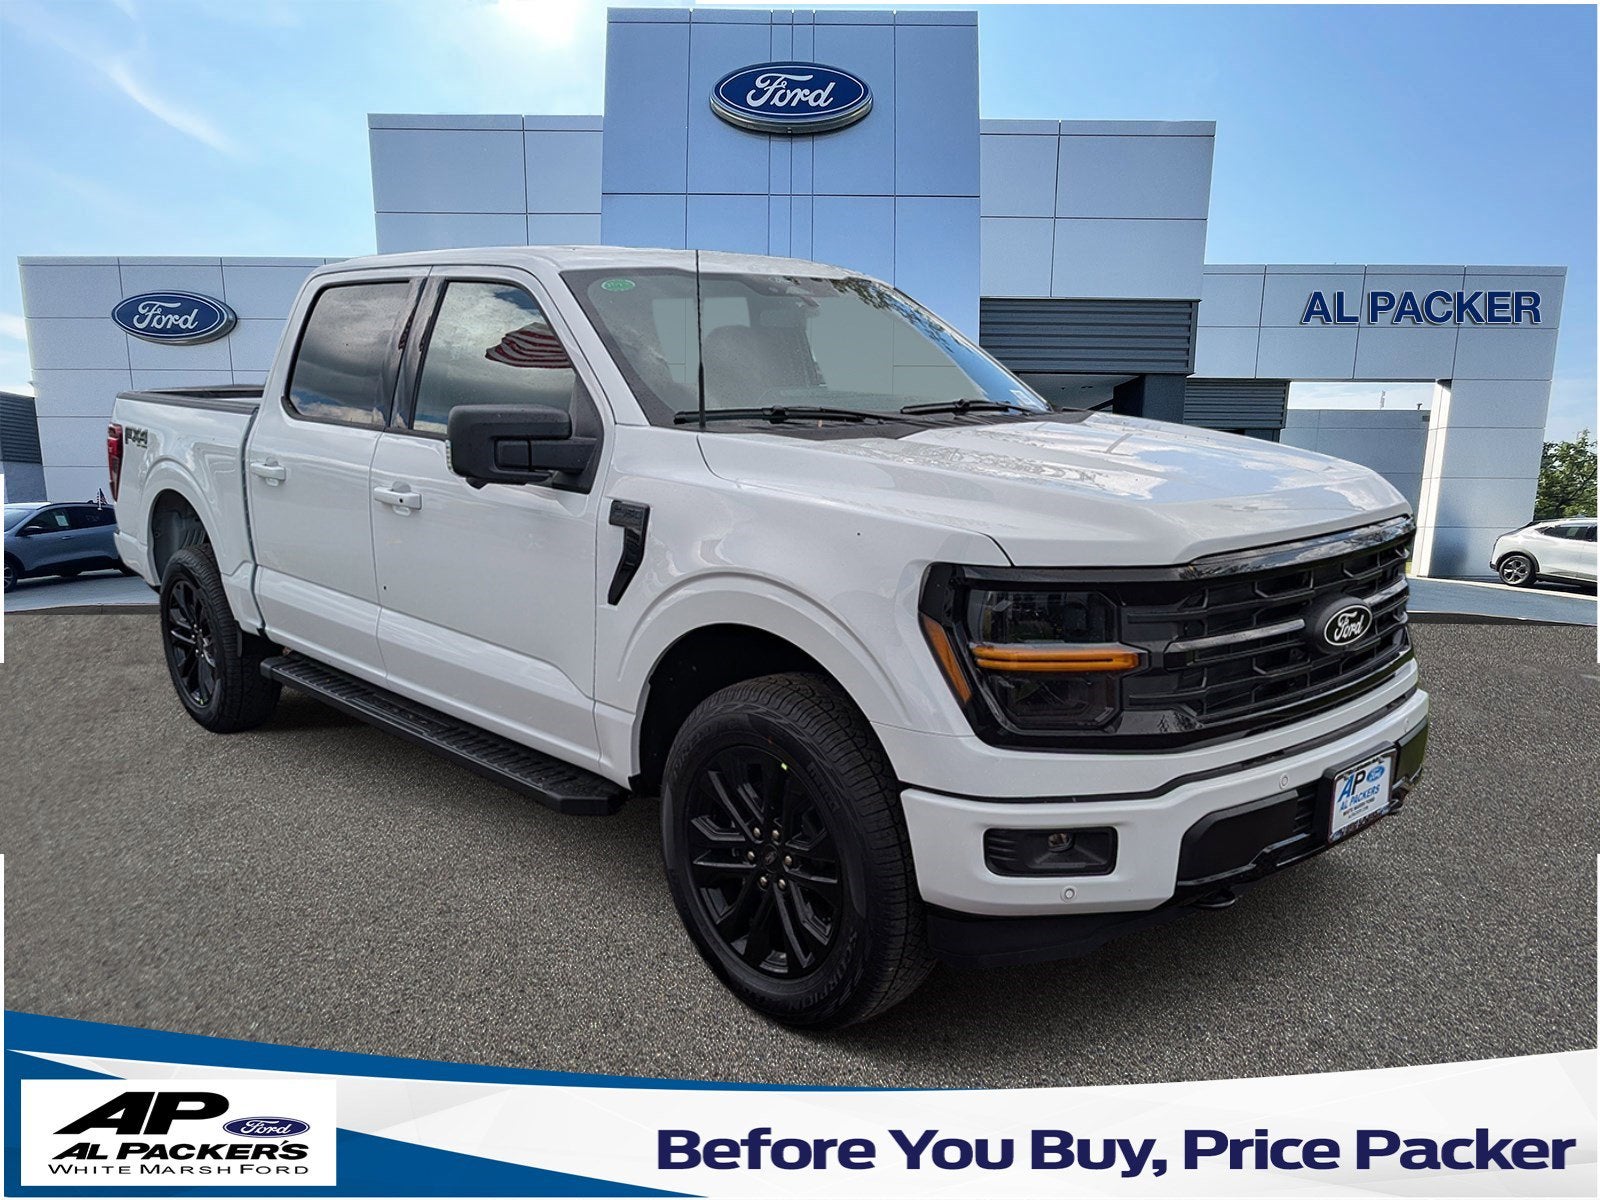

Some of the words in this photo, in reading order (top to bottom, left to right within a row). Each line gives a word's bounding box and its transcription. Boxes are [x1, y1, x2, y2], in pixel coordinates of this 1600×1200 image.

[746, 73, 836, 108] Ford
[133, 301, 199, 329] Ford
[1301, 290, 1360, 324] AL
[1368, 289, 1542, 325] PACKER
[1333, 611, 1365, 642] Ford
[1337, 769, 1366, 803] AP
